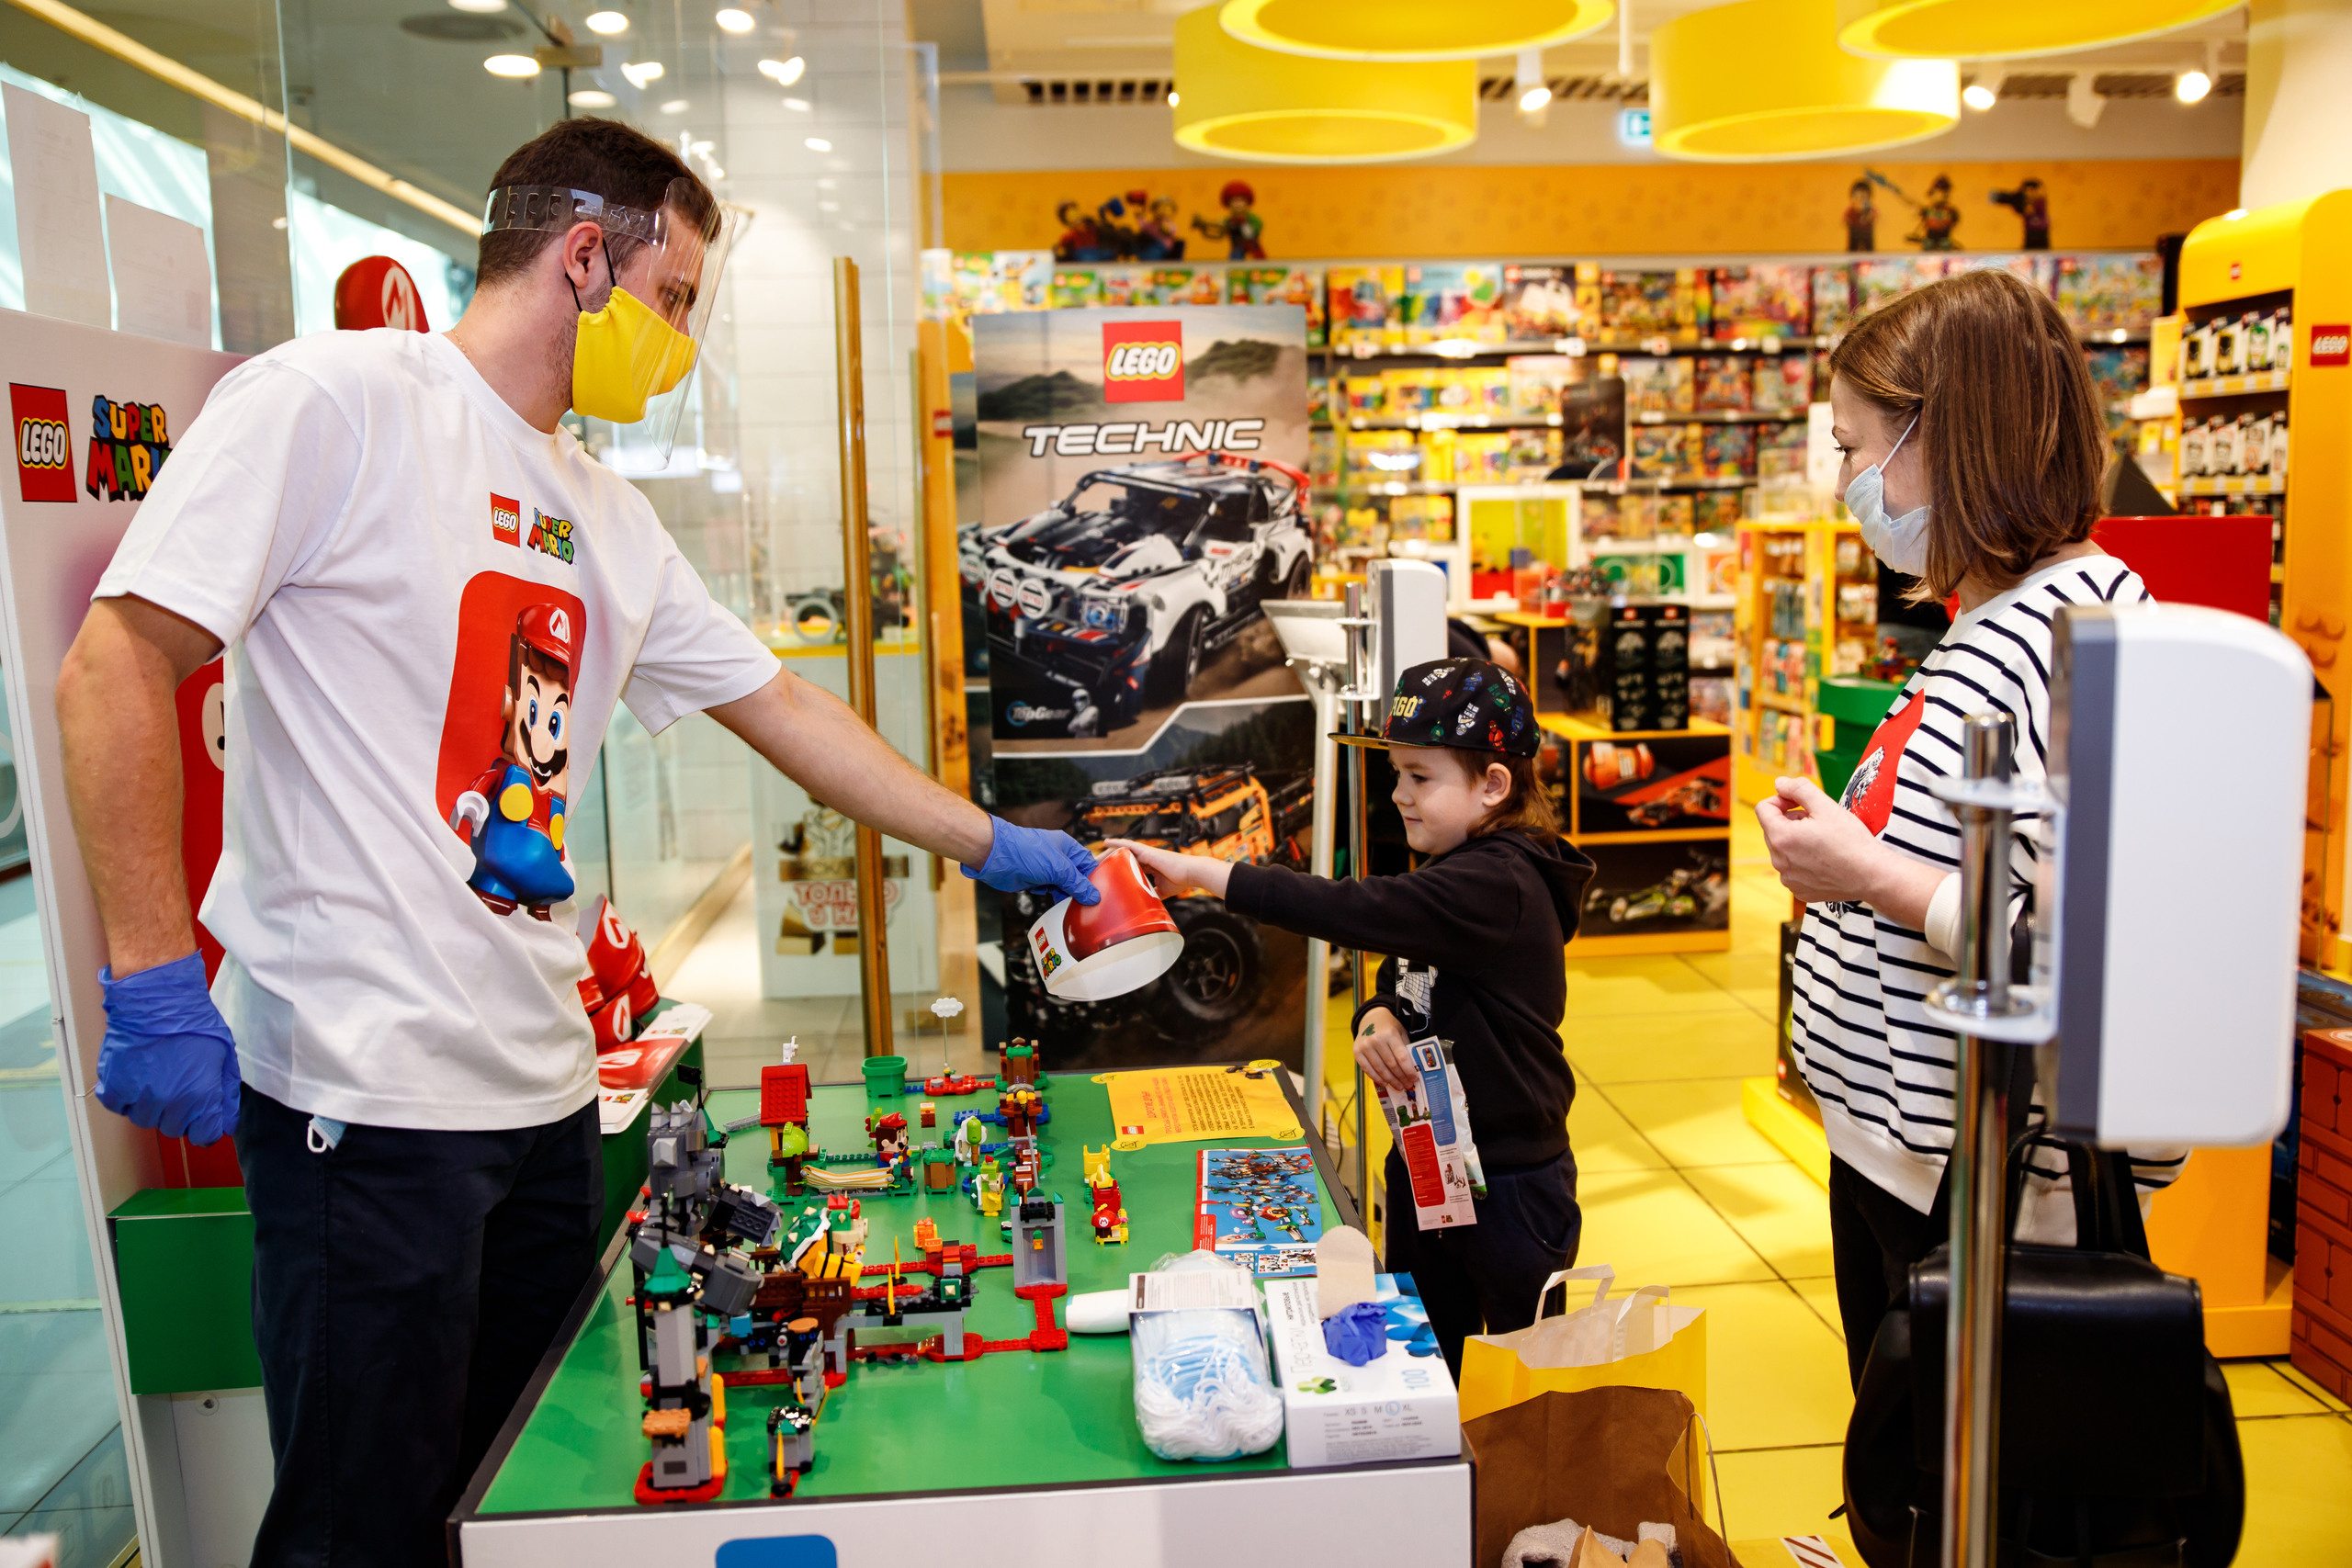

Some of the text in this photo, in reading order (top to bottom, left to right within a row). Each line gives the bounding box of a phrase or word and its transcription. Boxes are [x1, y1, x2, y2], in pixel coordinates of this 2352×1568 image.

[1109, 344, 1179, 378] LEGO
[93, 395, 169, 445] SUPER
[20, 421, 67, 467] LEGO
[1023, 419, 1264, 457] TECHNIC
[86, 436, 173, 502] MARI
[493, 507, 517, 531] LEGO
[533, 507, 573, 539] SUPER
[527, 524, 575, 565] MARIO
[793, 881, 899, 907] ТОЛЬО
[1043, 954, 1061, 980] MARIO
[1401, 1369, 1430, 1390] 100
